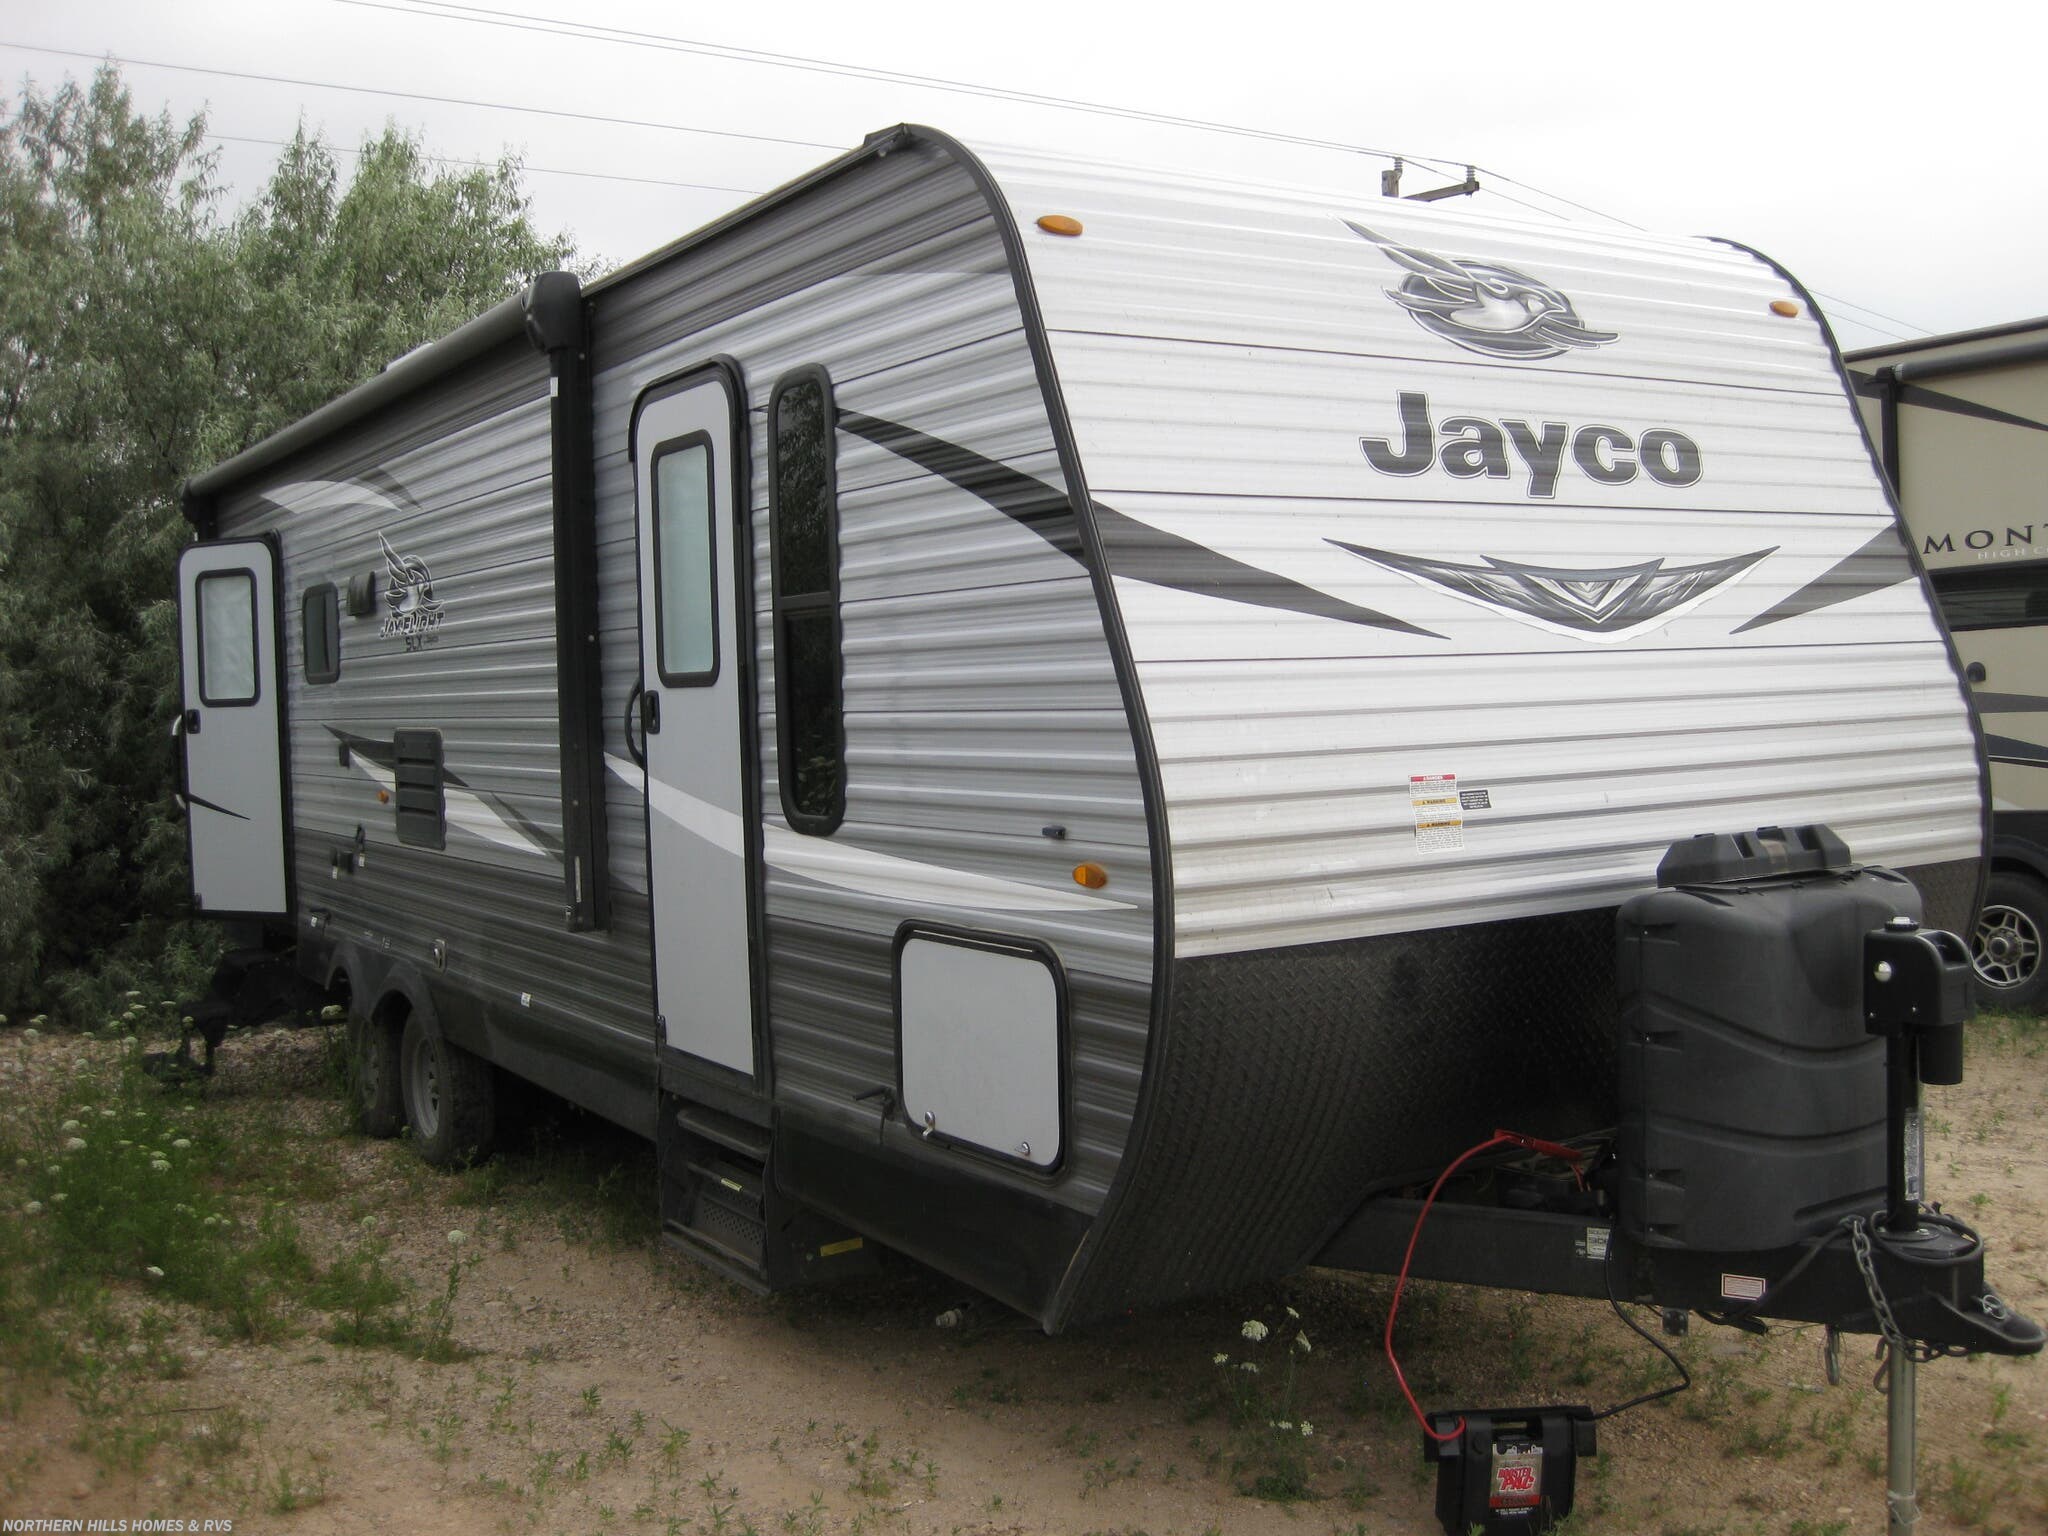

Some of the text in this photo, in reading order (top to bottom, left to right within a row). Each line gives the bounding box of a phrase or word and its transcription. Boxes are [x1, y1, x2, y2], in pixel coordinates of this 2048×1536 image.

[1359, 389, 1704, 499] Jayco
[1923, 523, 2048, 554] MON
[1978, 548, 2025, 559] HIGH
